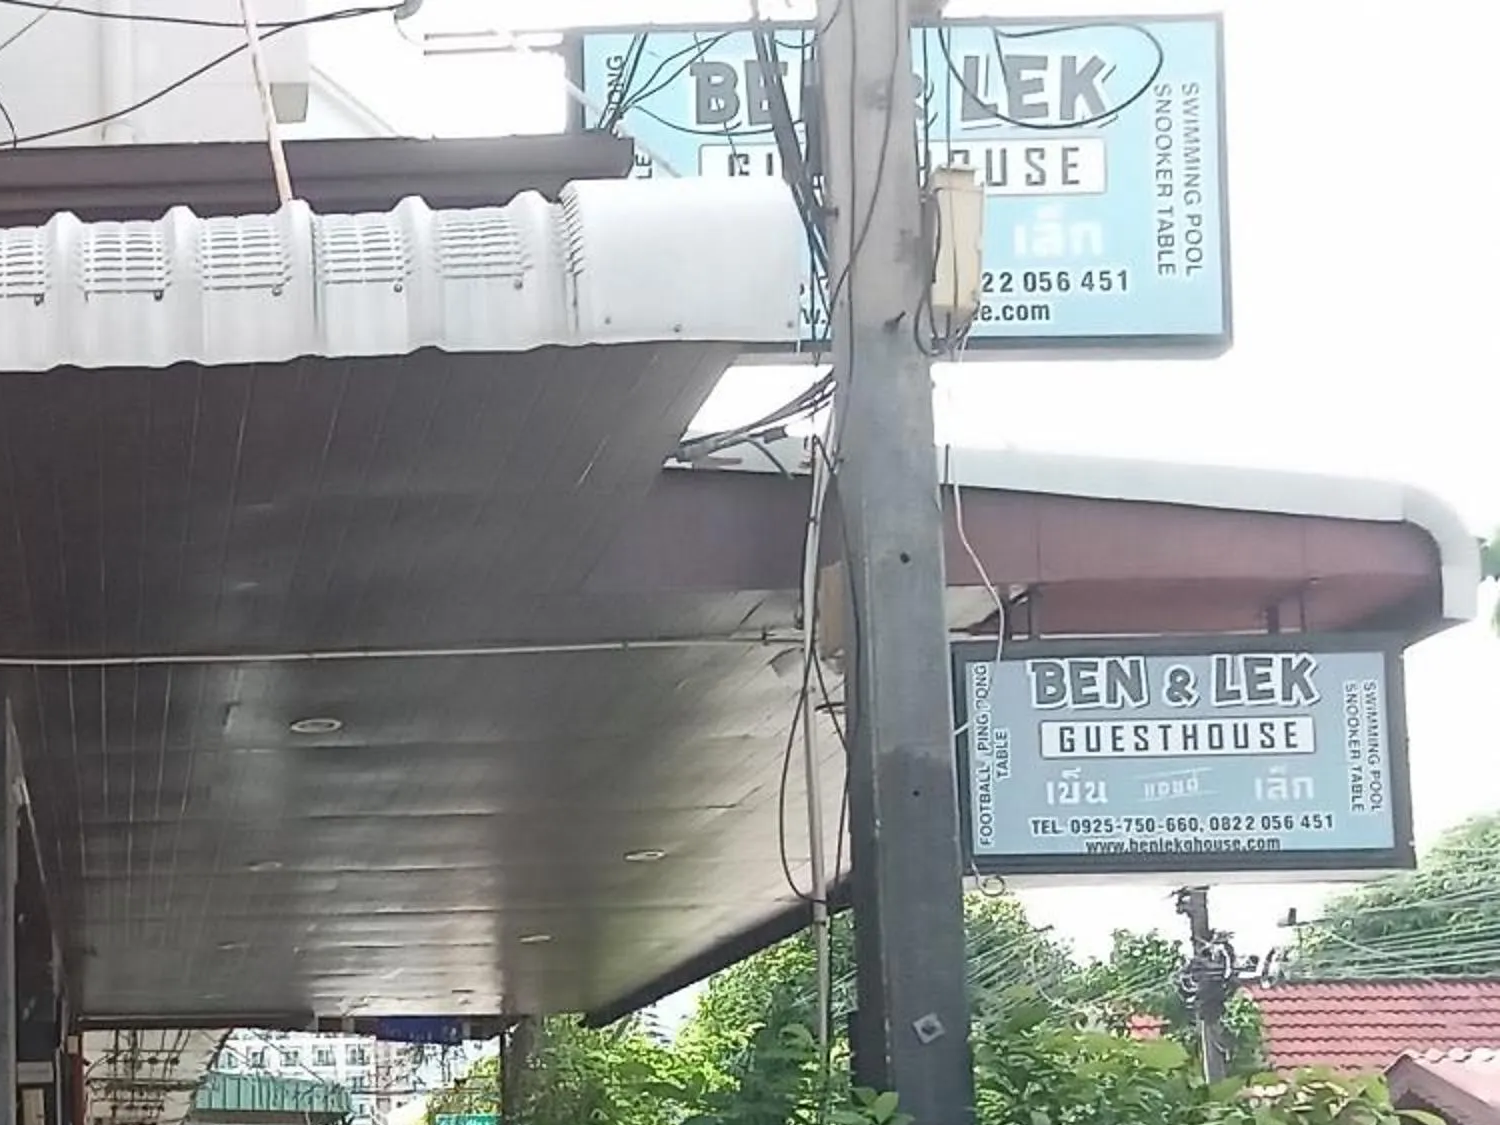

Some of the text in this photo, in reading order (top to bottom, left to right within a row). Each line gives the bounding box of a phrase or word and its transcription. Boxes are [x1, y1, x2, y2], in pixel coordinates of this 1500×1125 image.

[961, 55, 1106, 122] LEK
[1154, 84, 1176, 276] SNOOKER TABLE
[1182, 83, 1203, 278] SWIMMING POOL
[1023, 271, 1071, 293] 056
[1081, 269, 1128, 292] 451
[1030, 655, 1319, 708] BEN & LEK
[975, 713, 990, 752] PING
[995, 730, 1009, 779] TABLE
[1059, 720, 1300, 754] GUESTHOUSE
[1345, 683, 1365, 812] SNOOKER TABLE
[1364, 681, 1383, 812] SWIMMING POOL
[1209, 815, 1255, 832] 0822
[1261, 814, 1294, 830] 056
[1300, 813, 1334, 830] 451
